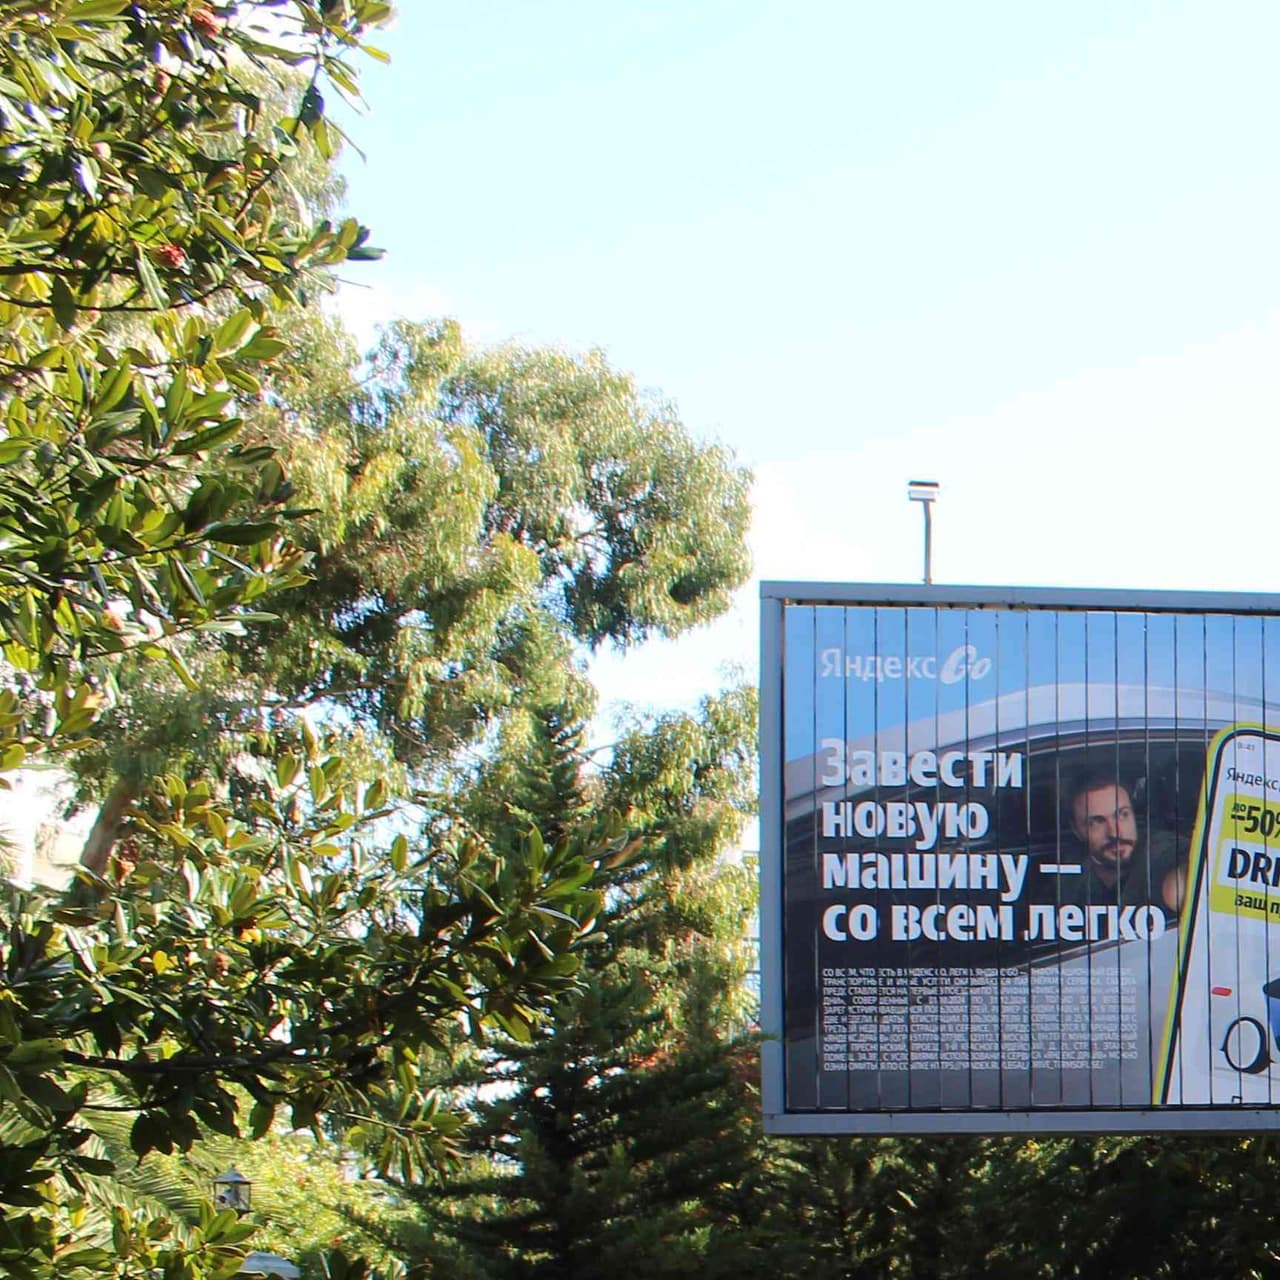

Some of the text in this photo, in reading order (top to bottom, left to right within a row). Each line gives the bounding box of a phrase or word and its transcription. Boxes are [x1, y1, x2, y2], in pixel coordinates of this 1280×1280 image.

[820, 643, 993, 685] Яндекс Go
[820, 737, 1023, 788] Завести
[1226, 767, 1280, 793] Яндекс
[821, 801, 989, 850] новую
[821, 852, 1029, 902] машину
[821, 903, 1167, 942] со всем легко
[1234, 892, 1267, 911] ваш
